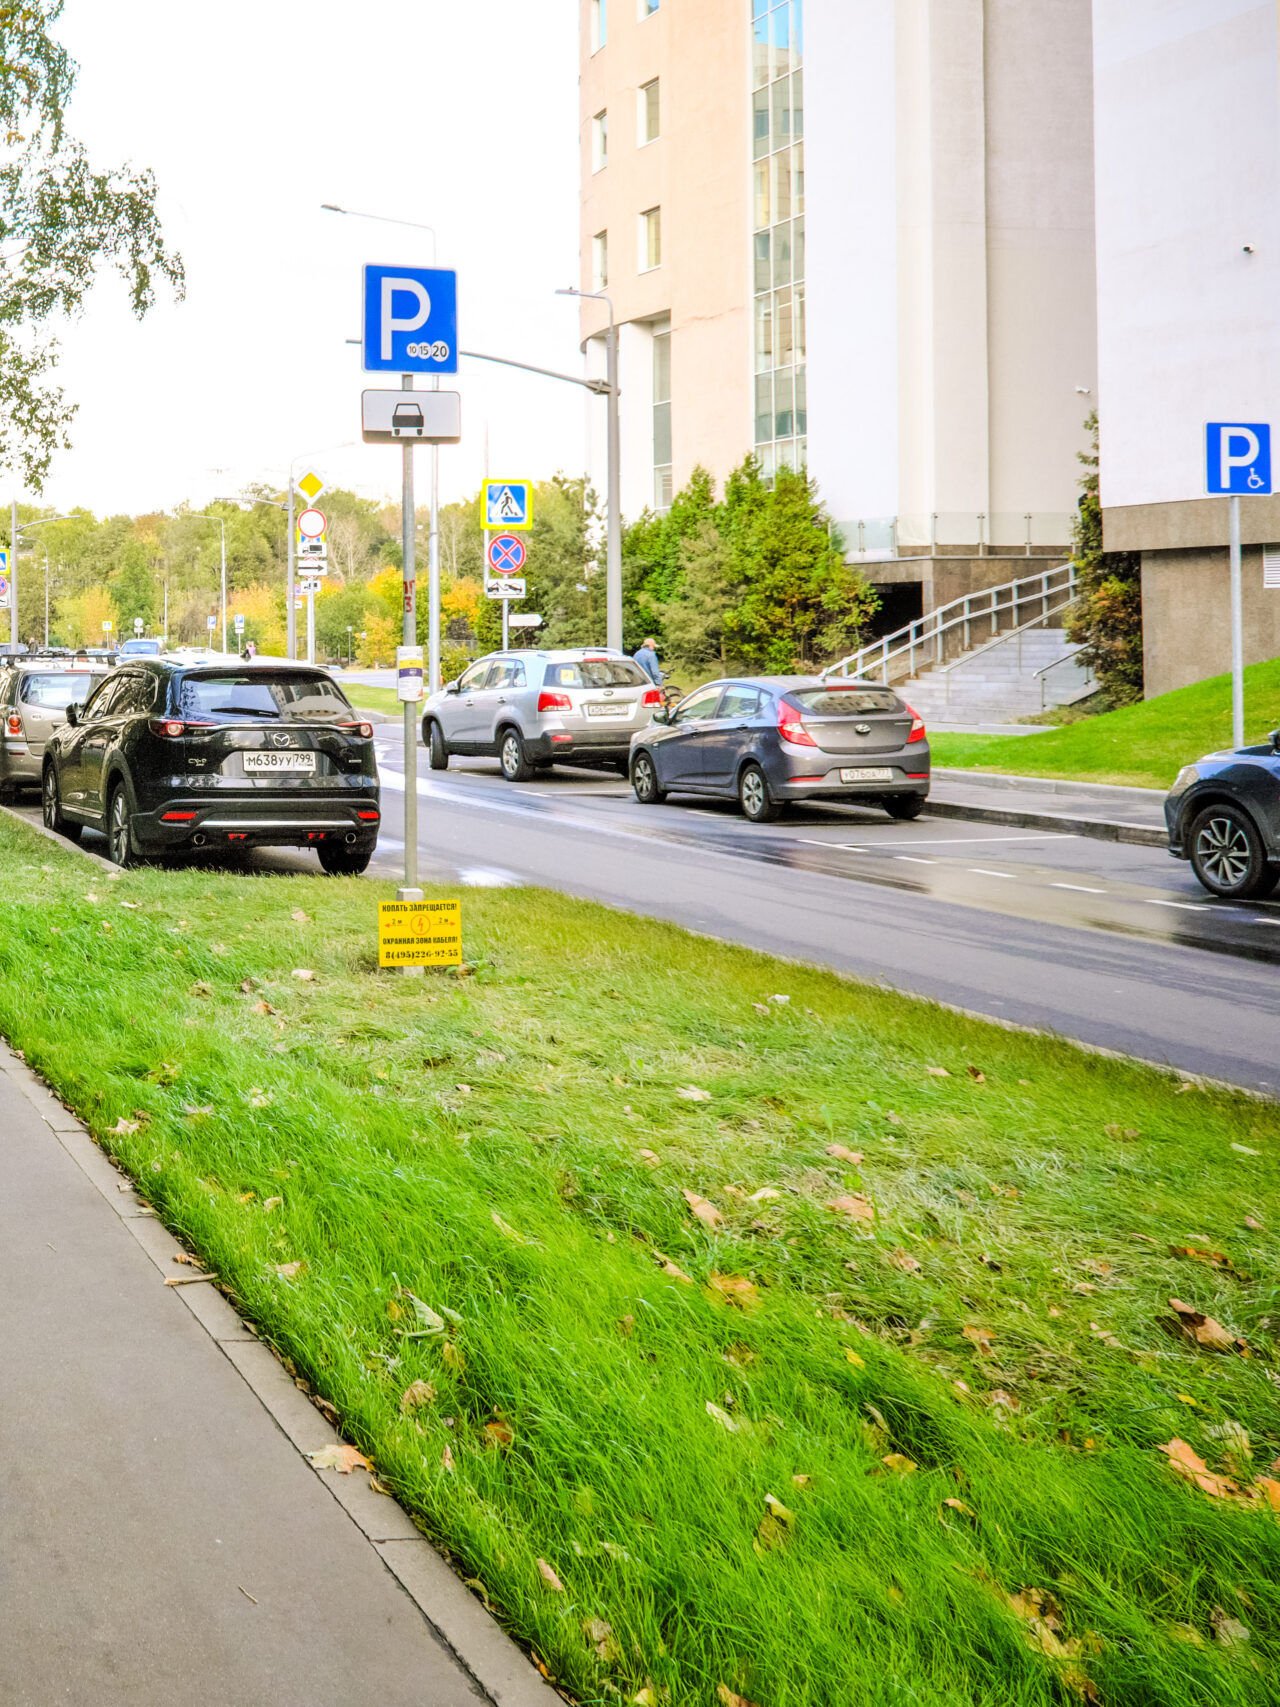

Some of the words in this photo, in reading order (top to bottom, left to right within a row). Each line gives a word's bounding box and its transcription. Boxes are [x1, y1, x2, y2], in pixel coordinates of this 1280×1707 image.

[381, 276, 431, 361] P
[409, 346, 417, 354] 10
[420, 346, 429, 355] 15
[432, 345, 448, 358] 20
[1220, 426, 1260, 489] P
[294, 753, 311, 763] 799
[382, 904, 408, 912] КОПАТЬ
[409, 903, 457, 912] ЗАПРЕЩАЕТСЯ!
[382, 937, 415, 945] ОХРАННАЯ
[432, 936, 458, 944] КАБЕЛЯ!
[385, 949, 459, 960] 8(495)226-92-55
